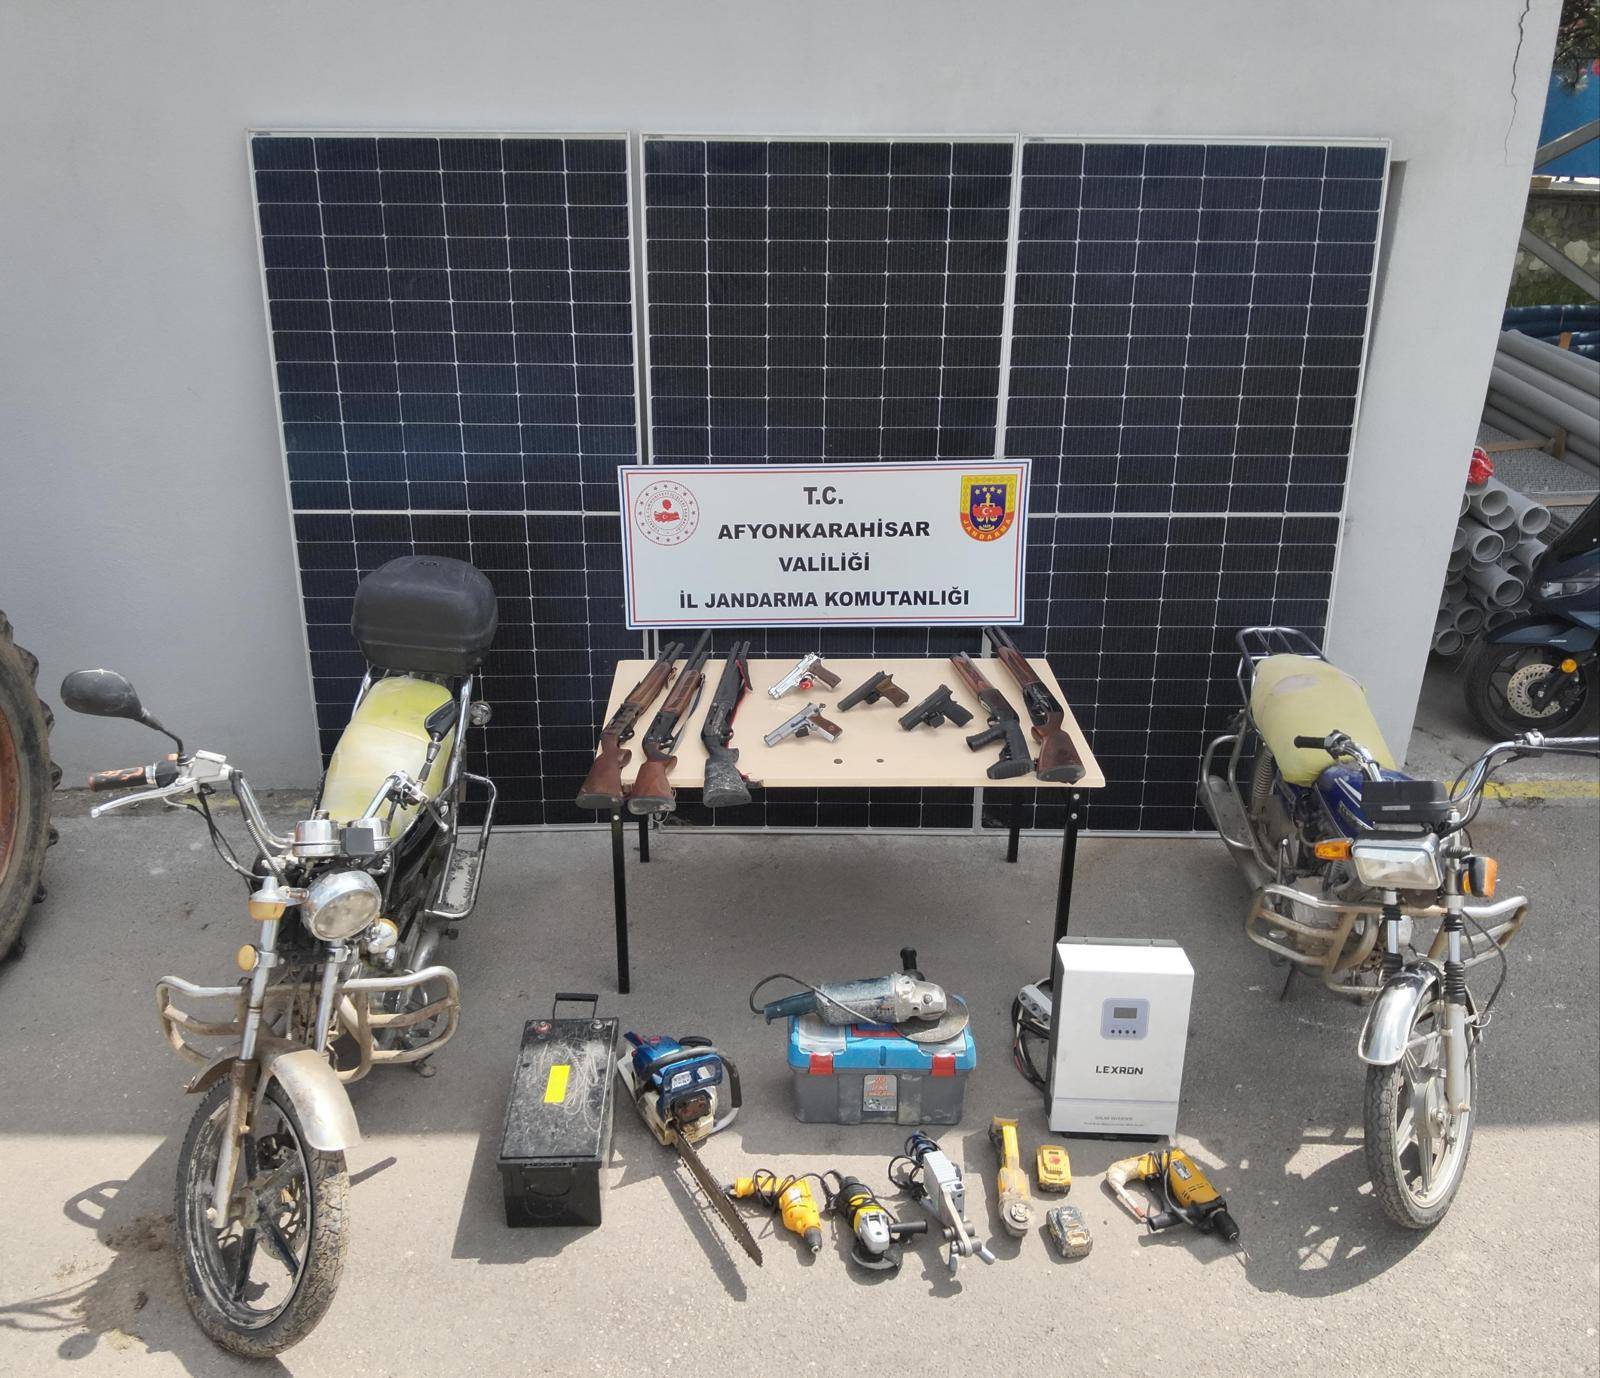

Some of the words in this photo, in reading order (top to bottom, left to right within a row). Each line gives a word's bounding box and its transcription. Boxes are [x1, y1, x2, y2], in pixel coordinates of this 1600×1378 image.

[804, 487, 843, 504] T.C.
[718, 519, 930, 539] AFYONKARAHİSAR
[963, 519, 1011, 540] JANDARMA
[779, 552, 869, 572] VALİLİĞİ
[680, 590, 698, 608] İL
[705, 592, 818, 608] JANDARMA
[825, 587, 968, 606] KOMUTANLIĞI
[1095, 1065, 1144, 1075] LEXRON
